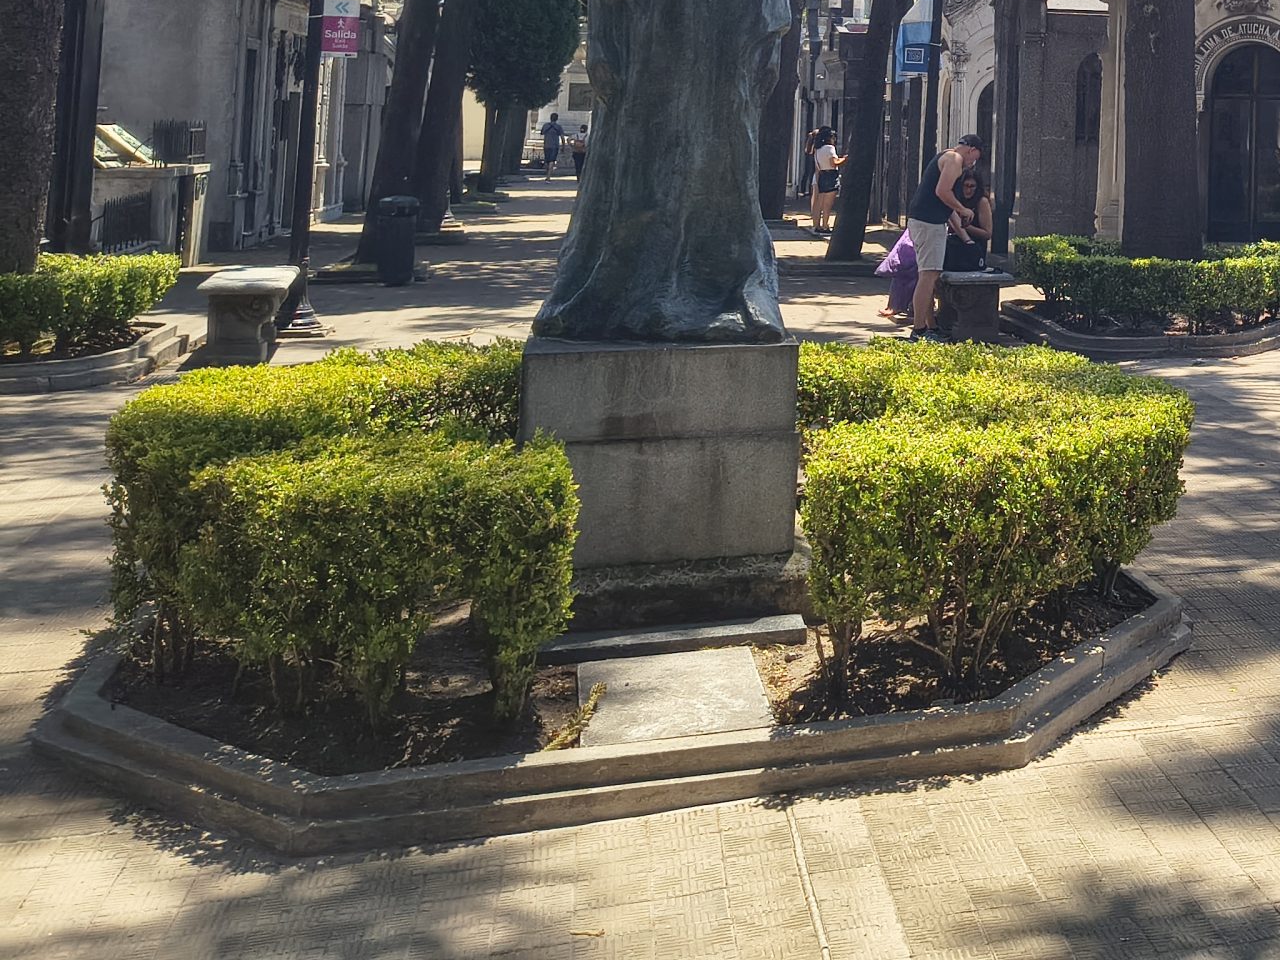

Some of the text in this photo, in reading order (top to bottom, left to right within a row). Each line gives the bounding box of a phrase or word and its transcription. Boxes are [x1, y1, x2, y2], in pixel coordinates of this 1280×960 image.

[324, 30, 357, 39] Salida
[1200, 34, 1221, 54] LIMA
[1221, 26, 1234, 39] DE
[1238, 23, 1270, 37] ATUCHA
[1273, 29, 1280, 40] A
